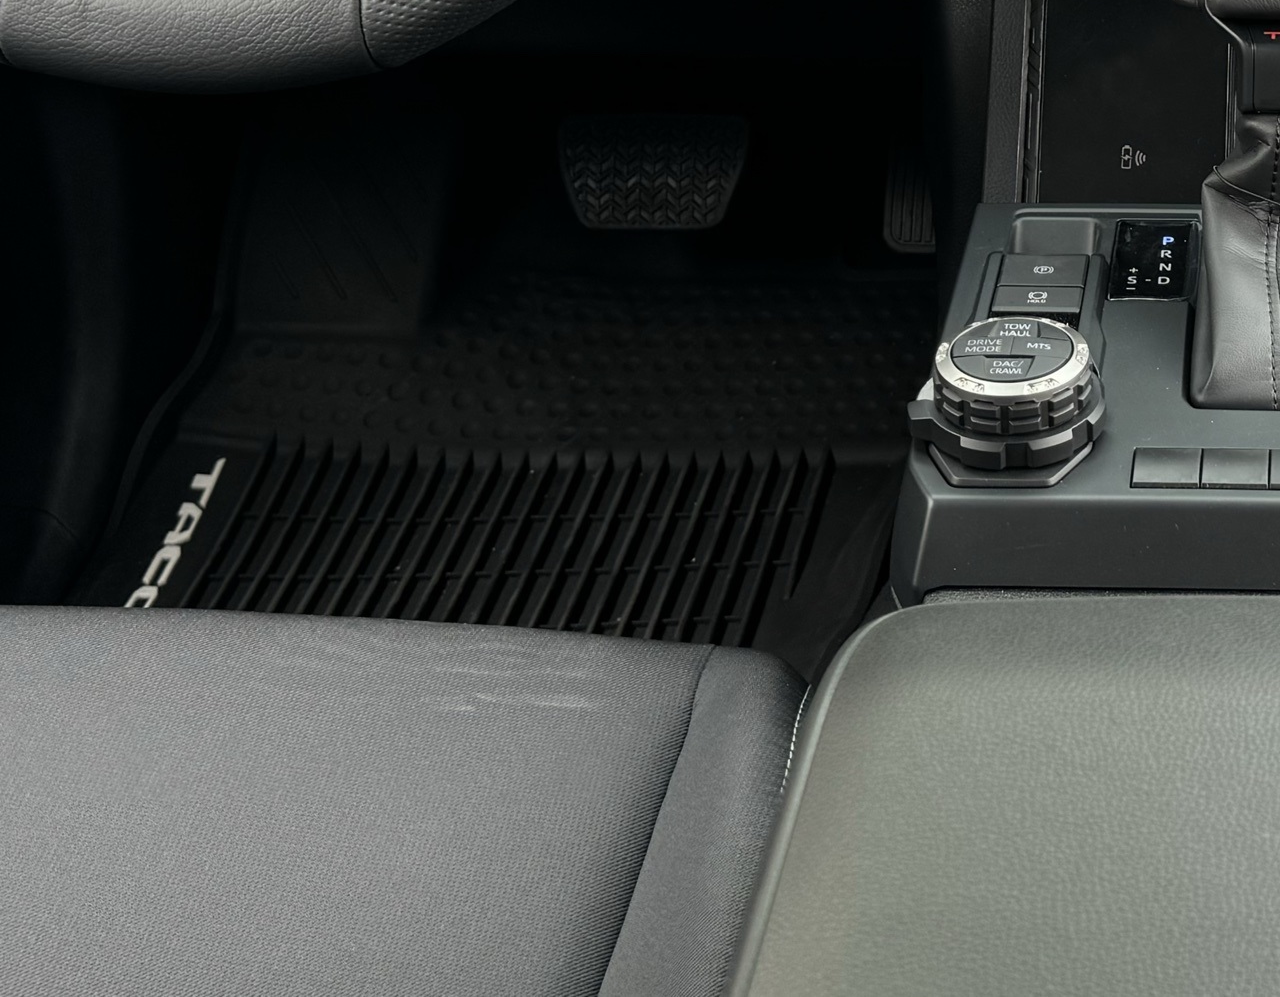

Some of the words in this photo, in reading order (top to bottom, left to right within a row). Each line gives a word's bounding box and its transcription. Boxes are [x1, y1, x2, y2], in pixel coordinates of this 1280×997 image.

[1162, 236, 1175, 246] P
[1160, 249, 1172, 258] R
[1159, 263, 1172, 271] N
[1127, 275, 1138, 284] S
[1157, 276, 1171, 285] D
[967, 338, 1003, 346] DRIVE
[1026, 342, 1052, 350] MTS
[964, 345, 1002, 353] MODE
[993, 360, 1024, 368] DAC/
[989, 367, 1024, 375] CRAWL
